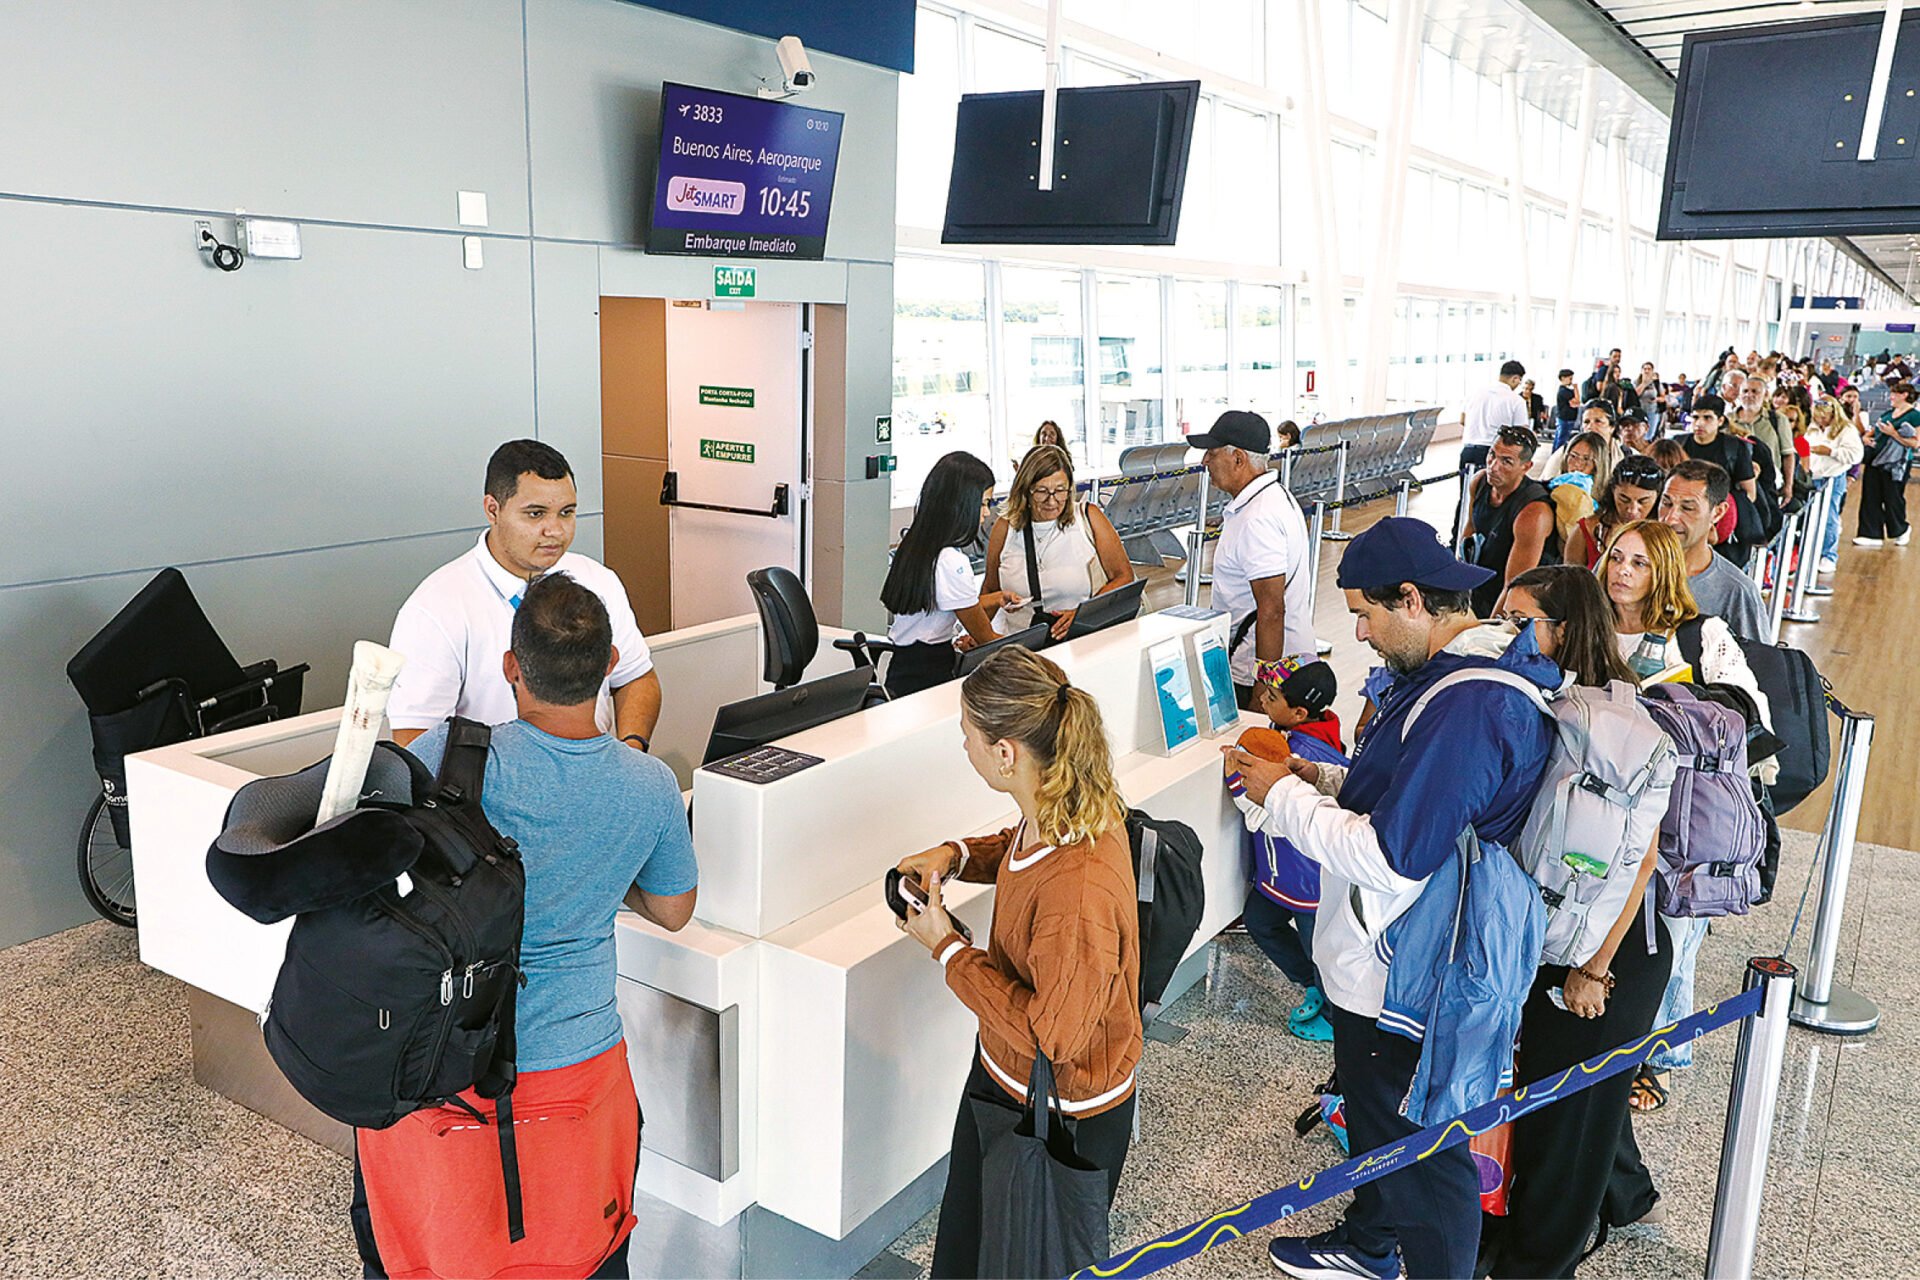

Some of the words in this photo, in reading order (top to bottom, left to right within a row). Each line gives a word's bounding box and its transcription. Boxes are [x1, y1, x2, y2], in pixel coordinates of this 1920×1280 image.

[693, 104, 723, 124] 3833
[673, 136, 720, 159] Buenos
[722, 143, 754, 165] Aires,
[757, 148, 822, 174] Aeroparque
[759, 186, 811, 218] 10:45
[685, 233, 746, 254] Embarque
[749, 236, 797, 254] Imediato
[716, 443, 745, 452] APERTE
[716, 451, 752, 461] EMPURRE
[1371, 1157, 1398, 1172] AIRPORT
